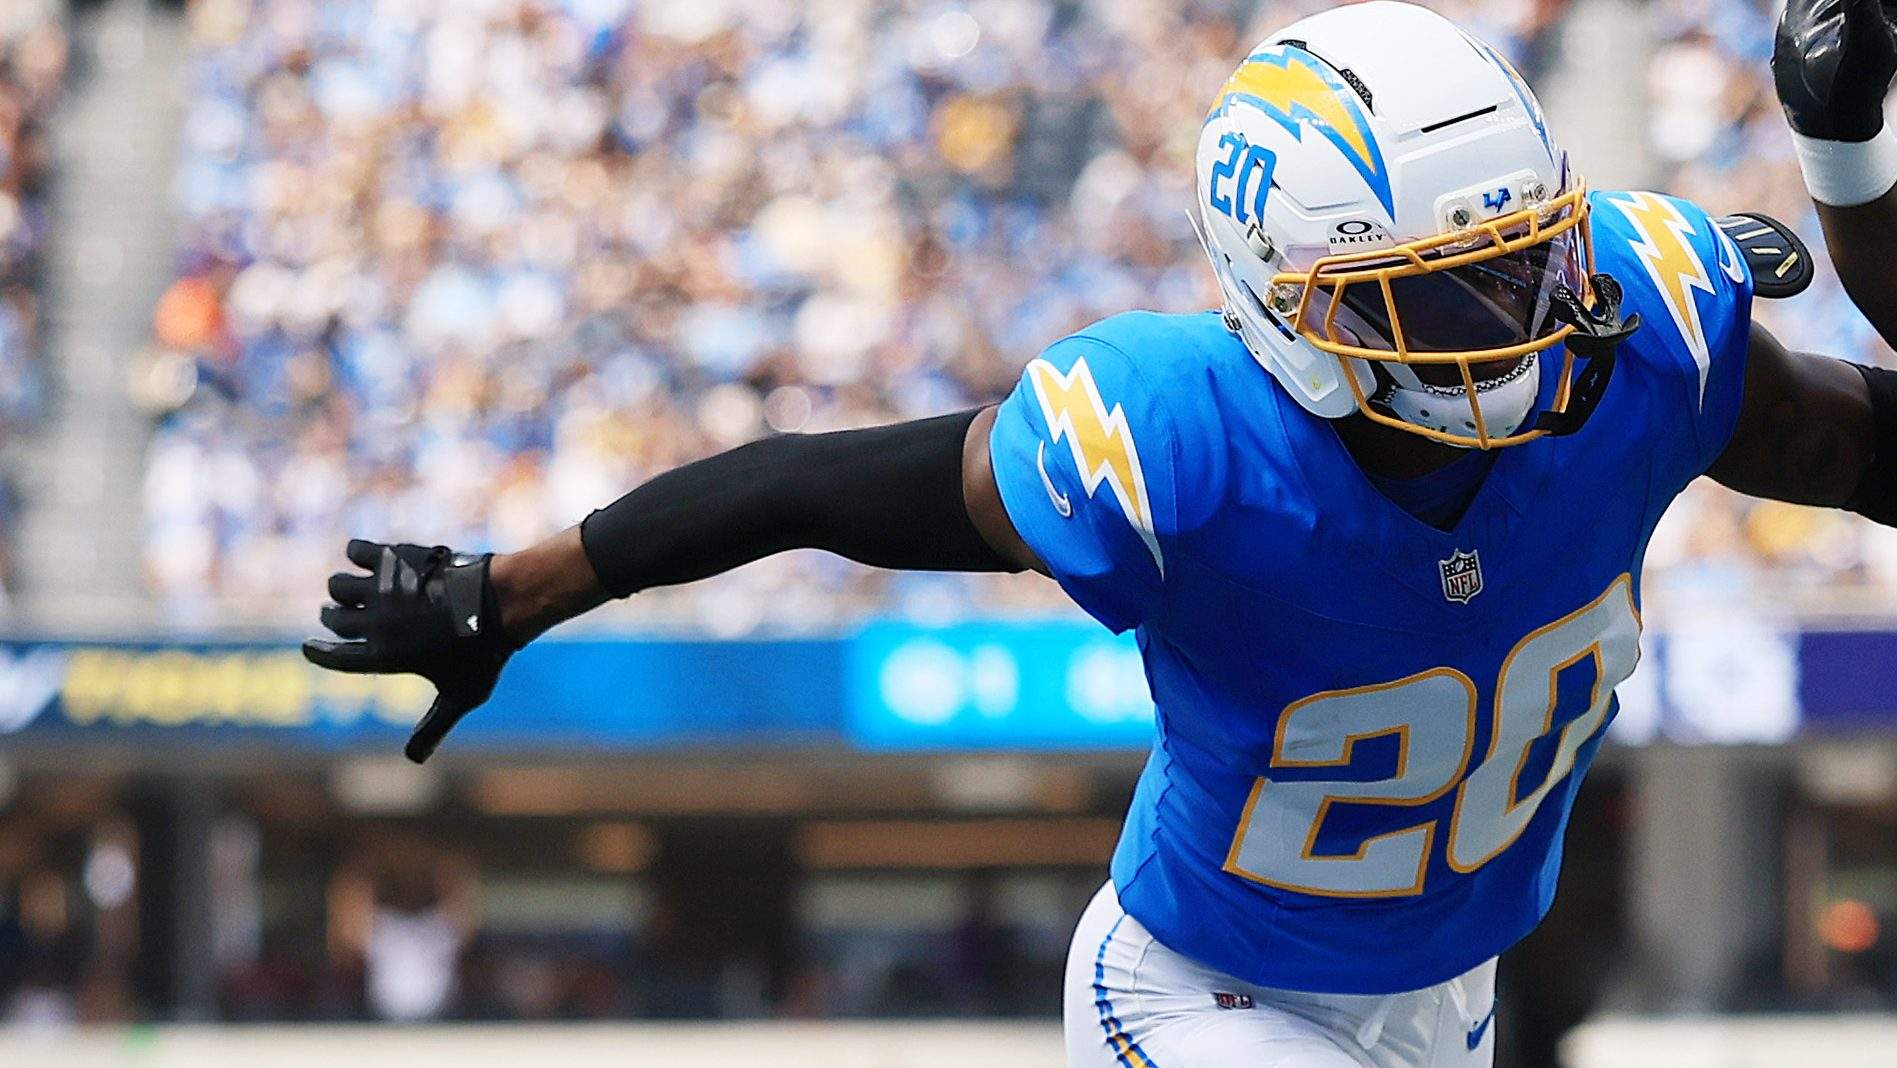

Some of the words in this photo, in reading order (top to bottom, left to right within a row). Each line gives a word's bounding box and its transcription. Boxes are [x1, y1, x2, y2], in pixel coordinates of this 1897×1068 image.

[1211, 131, 1277, 229] 20
[1330, 233, 1384, 245] OAKLEY
[1449, 573, 1478, 595] NFL
[1224, 572, 1642, 900] 20
